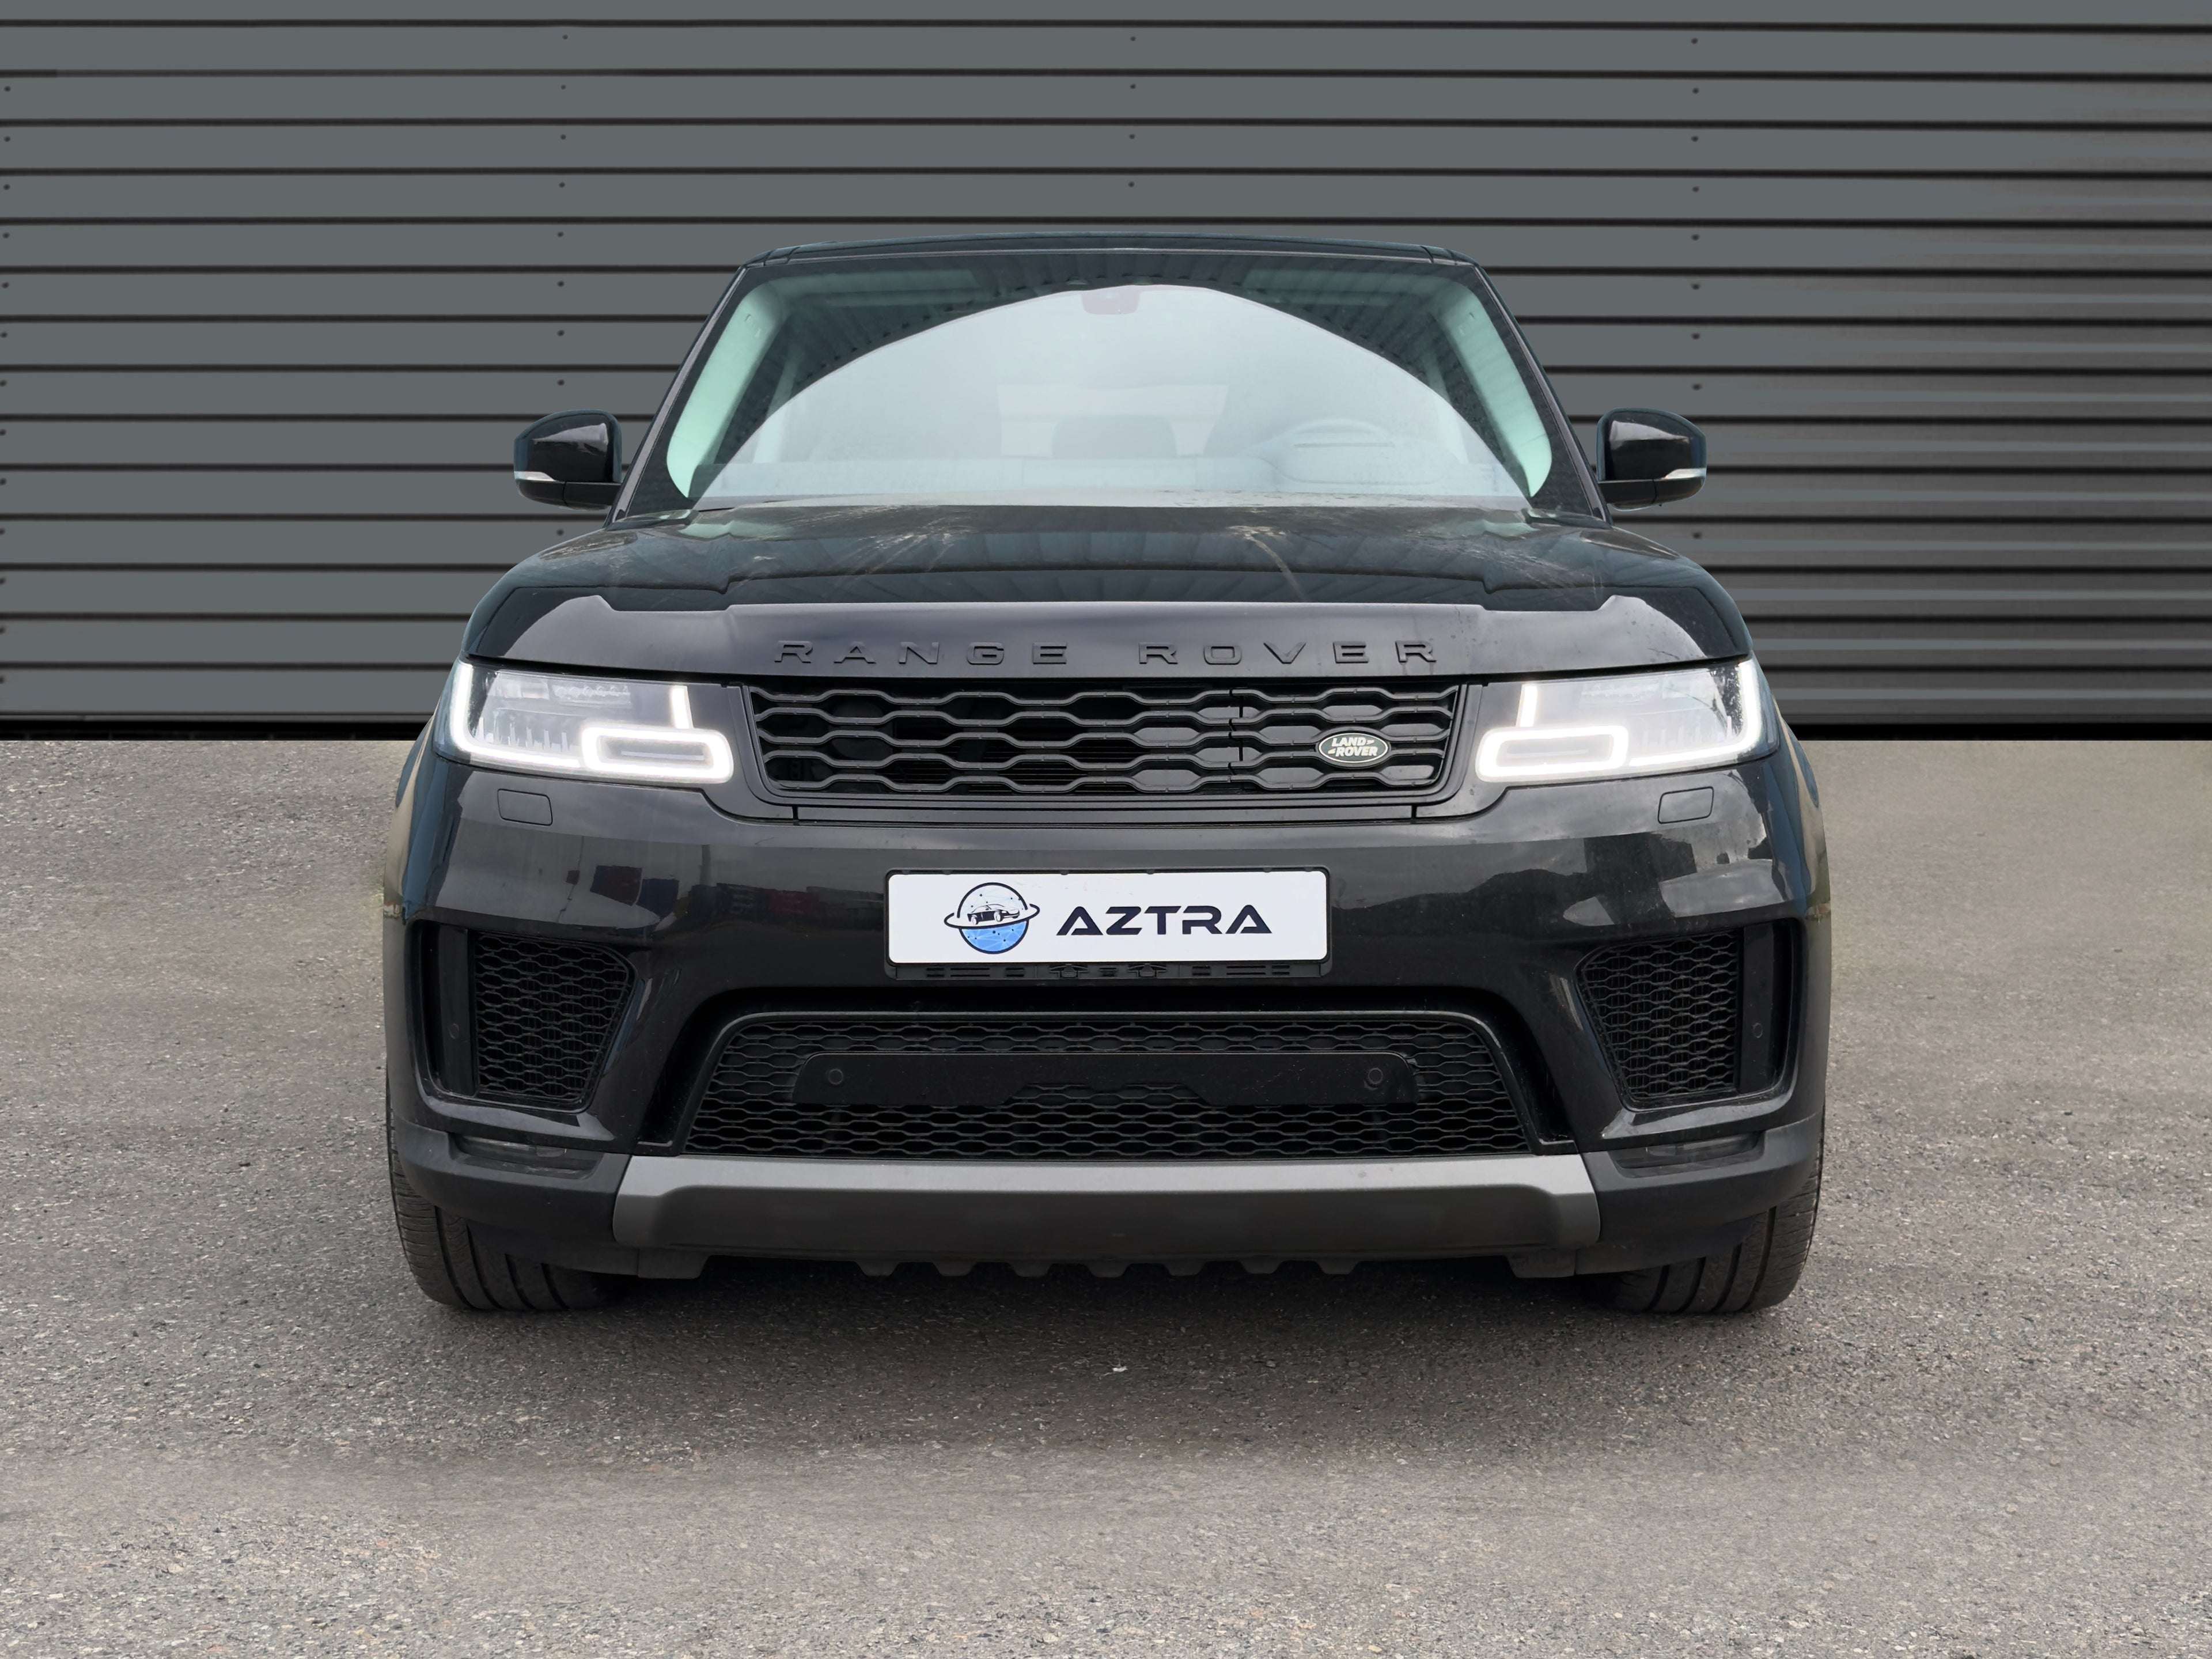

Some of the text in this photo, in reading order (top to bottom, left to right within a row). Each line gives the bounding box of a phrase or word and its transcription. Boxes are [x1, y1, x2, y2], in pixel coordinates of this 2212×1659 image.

[775, 641, 1437, 664] RANGE ROVER
[1332, 737, 1366, 747] LAND
[1336, 747, 1378, 756] ROVER
[1056, 905, 1272, 935] AZTRA
